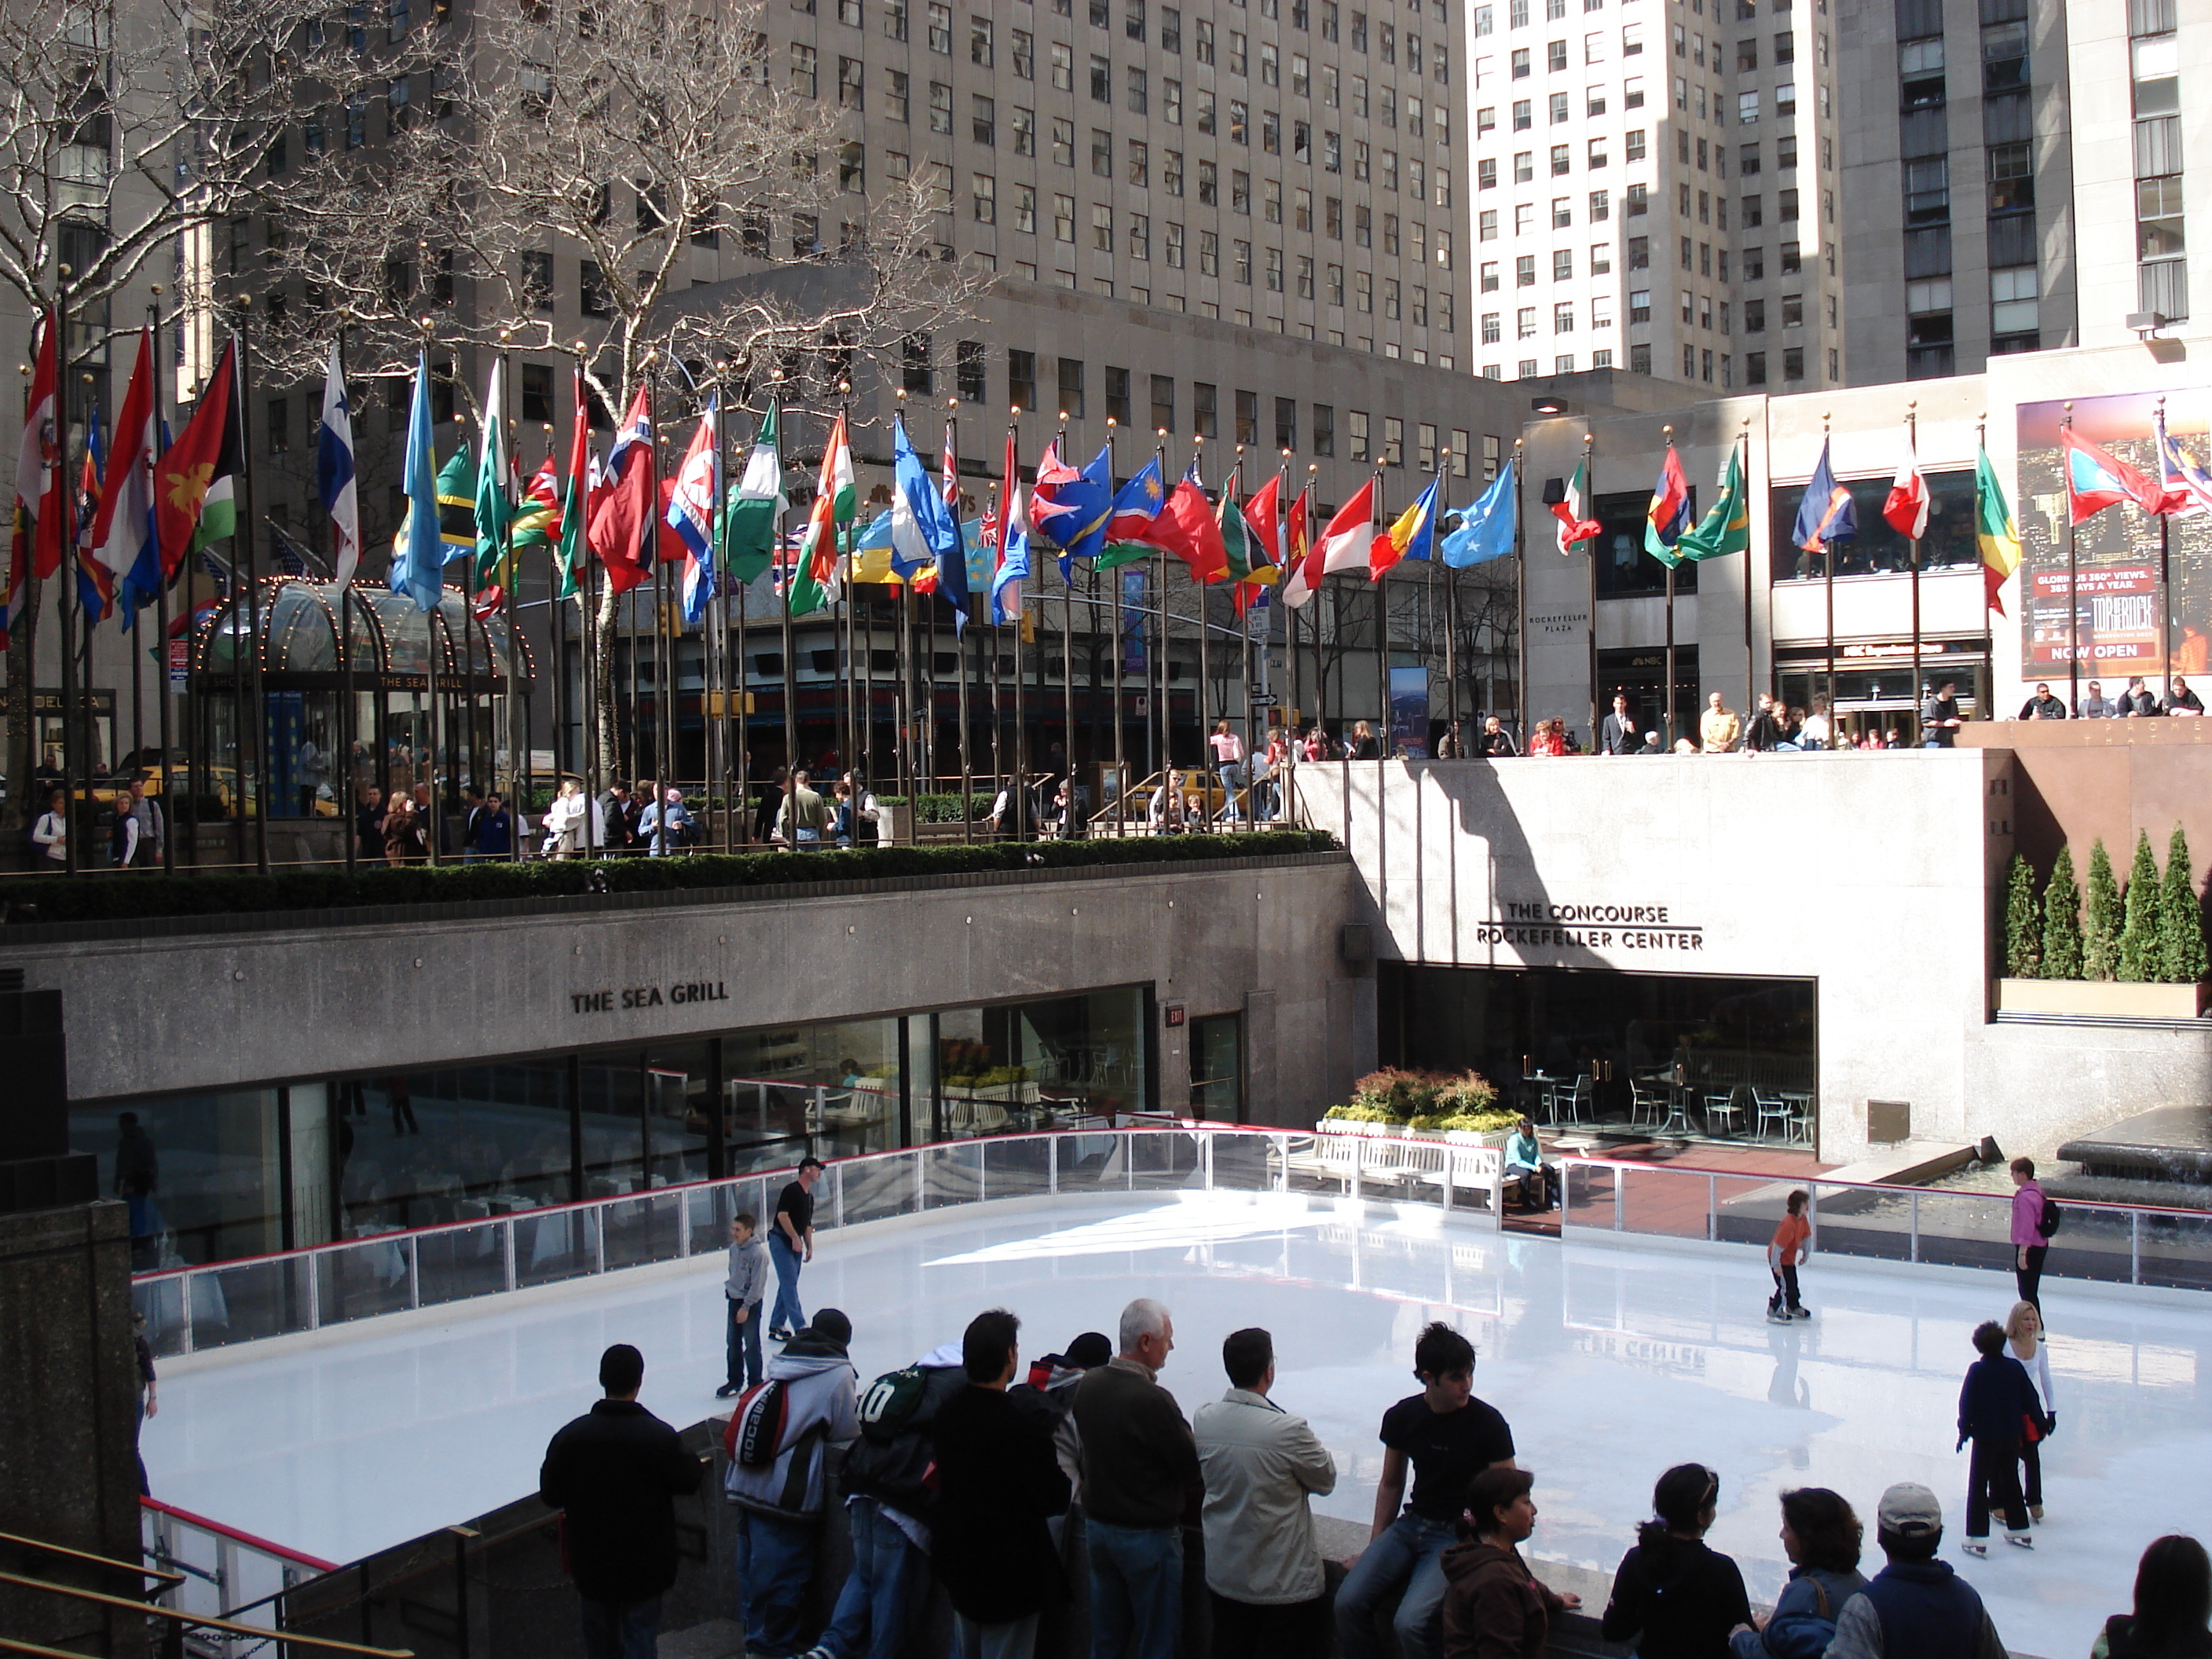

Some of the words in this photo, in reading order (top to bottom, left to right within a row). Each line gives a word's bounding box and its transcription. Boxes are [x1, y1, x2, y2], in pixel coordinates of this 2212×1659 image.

[2038, 572, 2086, 584] GLORIUS
[2114, 570, 2148, 580] VIEWS.
[2050, 584, 2067, 593] 365
[2076, 583, 2095, 591] AYS
[2097, 581, 2105, 590] A
[2106, 580, 2136, 589] YEAR.
[1529, 614, 1588, 624] ROCKEFELLER
[2091, 597, 2112, 632] TOP
[2121, 595, 2155, 632] ROCK
[2094, 644, 2137, 657] OPEN
[1644, 656, 1662, 665] NBC
[381, 677, 401, 687] THE
[407, 678, 427, 688] SEA
[435, 678, 462, 688] RILL
[1507, 903, 1541, 920] THE
[1548, 904, 1668, 923] CONCOURSE
[1477, 928, 1613, 948] ROCKEFELLER
[1621, 932, 1703, 950] CENTER
[571, 992, 613, 1013] THE
[622, 987, 664, 1009] SEA
[670, 981, 730, 1005] GRILL
[1171, 1009, 1182, 1023] EXIT
